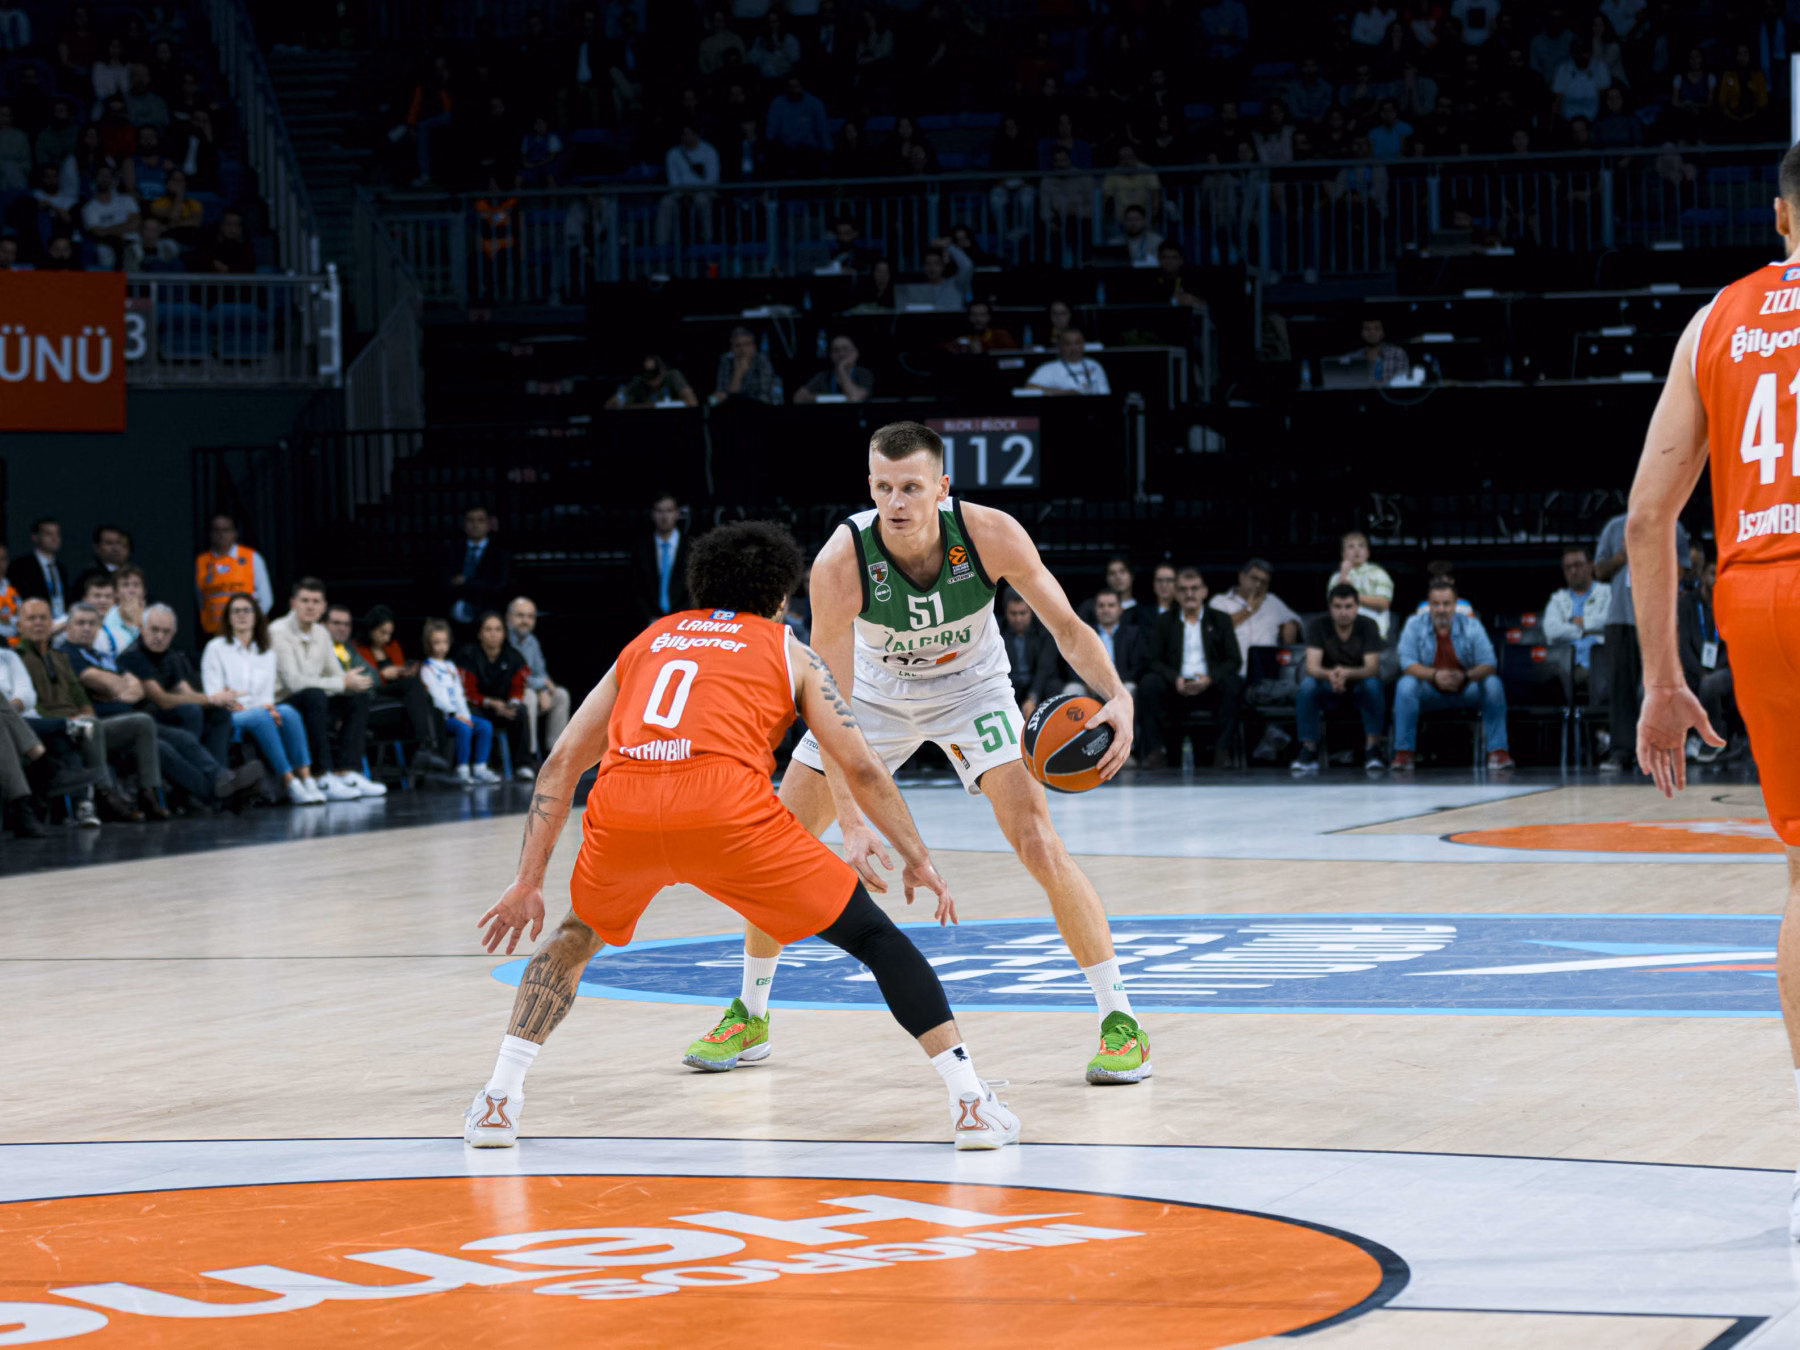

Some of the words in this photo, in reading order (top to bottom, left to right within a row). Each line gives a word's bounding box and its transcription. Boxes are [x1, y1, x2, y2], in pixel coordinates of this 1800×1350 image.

[0, 325, 112, 382] ÜNÜ
[942, 435, 1034, 485] 112
[677, 619, 743, 634] LARKIN
[907, 591, 944, 630] 51
[650, 633, 747, 653] Bilyoner
[642, 659, 699, 729] 0
[973, 710, 1018, 753] 51
[988, 924, 1457, 995] ANADOLU
